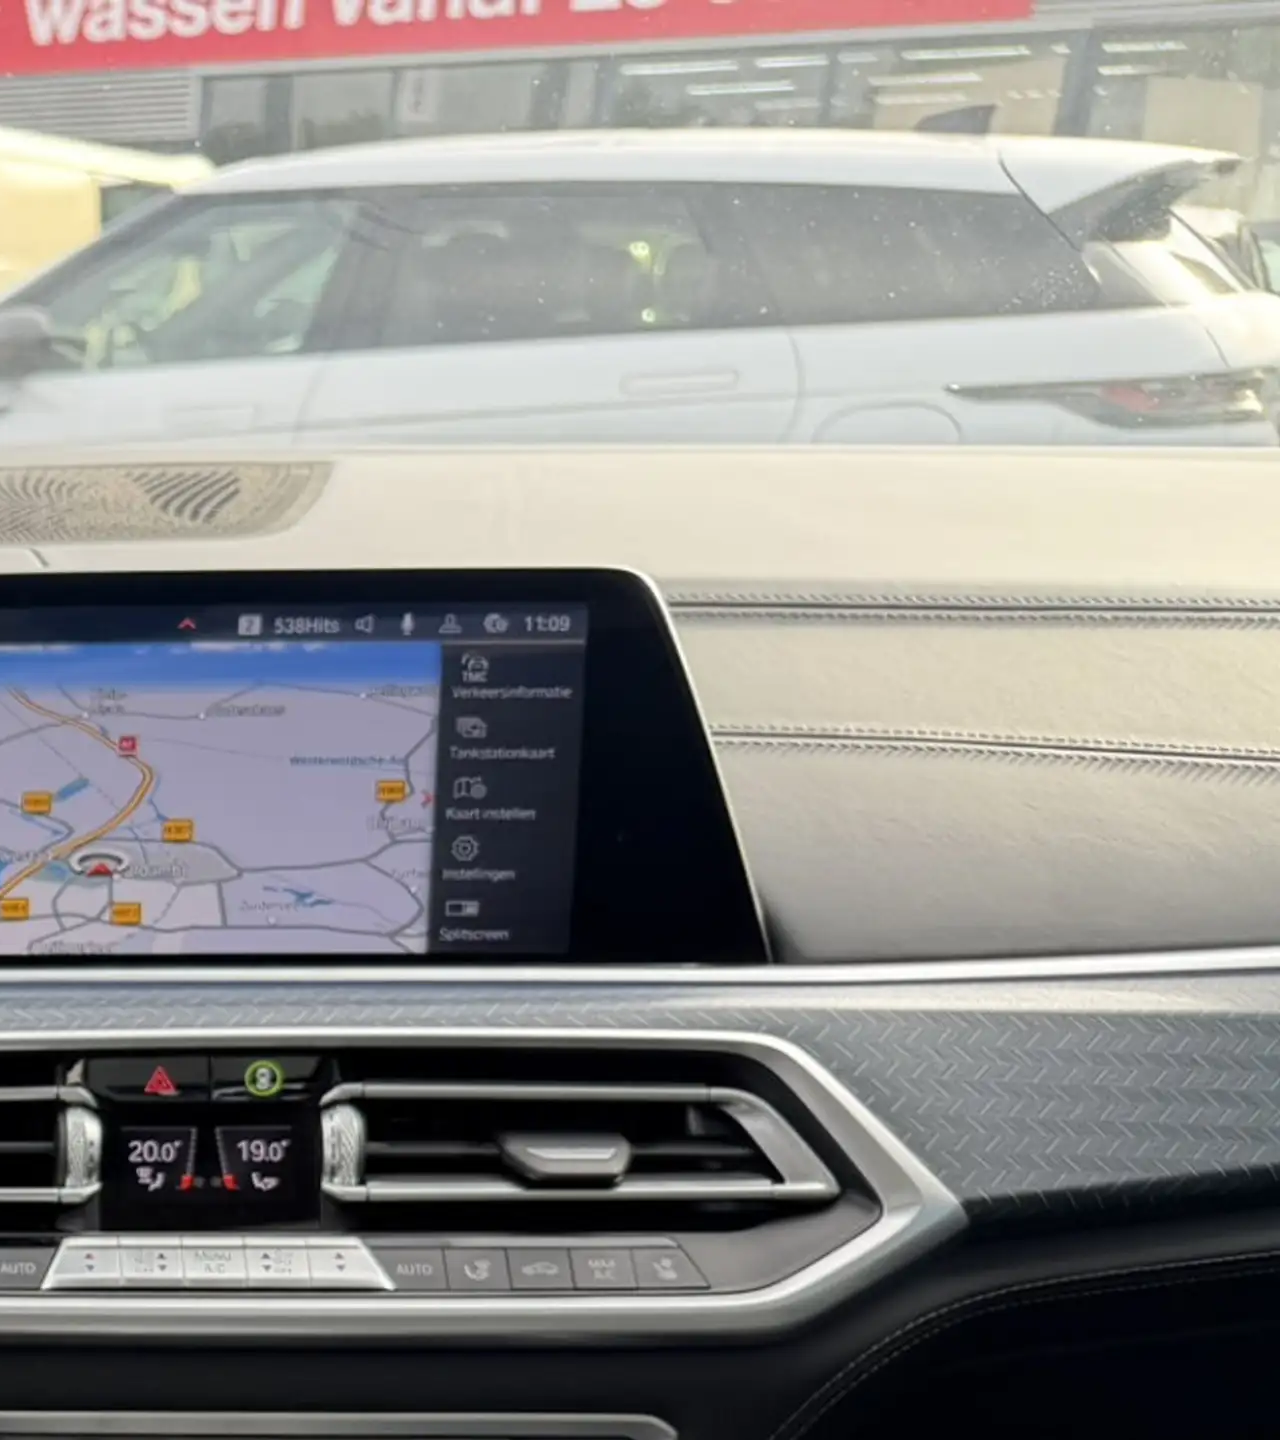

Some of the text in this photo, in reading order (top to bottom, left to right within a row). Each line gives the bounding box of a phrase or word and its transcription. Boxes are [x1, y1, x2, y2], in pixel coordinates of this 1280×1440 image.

[274, 616, 341, 635] 538Hits
[524, 615, 571, 632] 11:09
[450, 746, 557, 760] Tankstationkaart
[441, 868, 517, 882] Instellingen
[439, 928, 510, 943] Splitscreen
[0, 1261, 37, 1276] AUTO
[396, 1262, 434, 1277] AUTO
